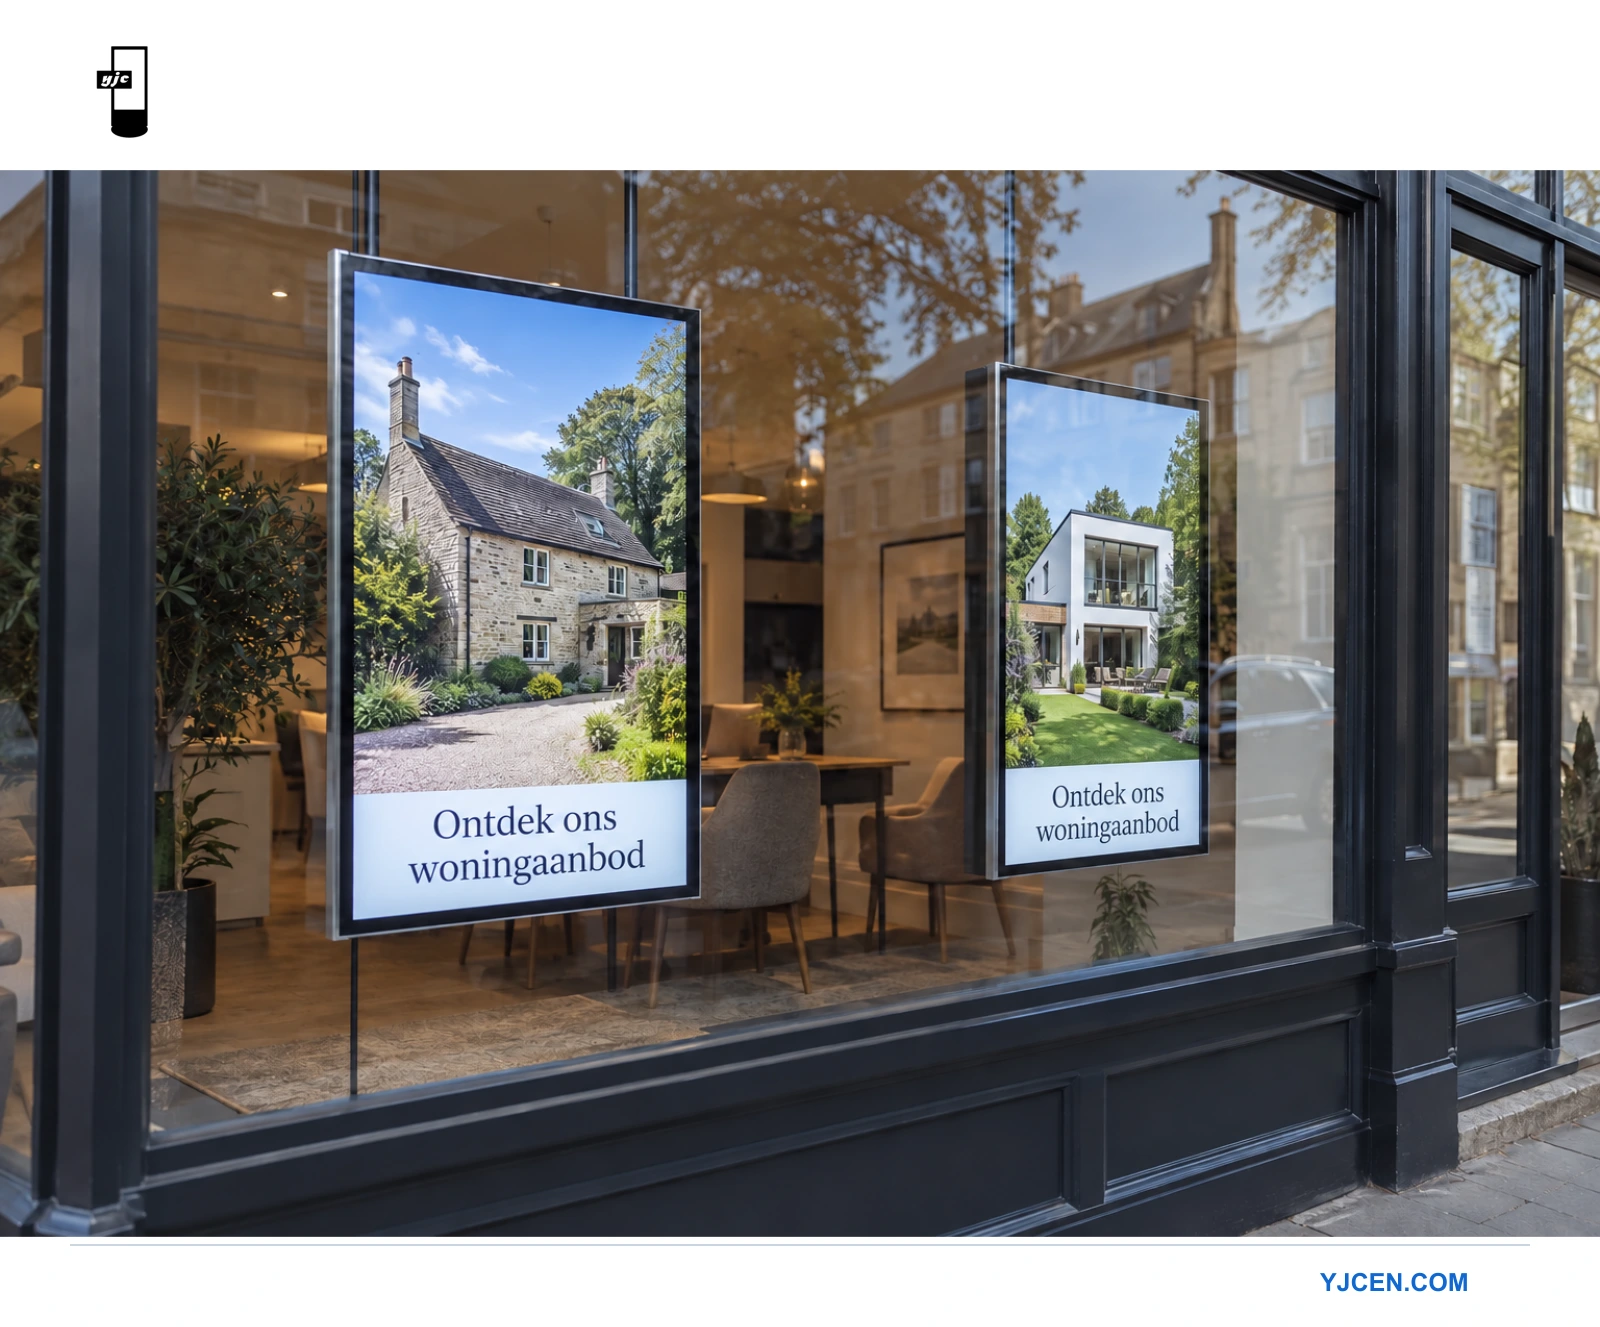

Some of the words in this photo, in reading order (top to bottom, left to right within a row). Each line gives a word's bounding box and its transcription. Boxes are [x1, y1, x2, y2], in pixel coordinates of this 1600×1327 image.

[1052, 781, 1126, 809] Ontdek
[1131, 786, 1165, 804] ons
[433, 803, 555, 840] Ontdek
[563, 810, 617, 833] ons
[1035, 808, 1180, 844] woningaanbod
[408, 839, 646, 884] woningaanbod
